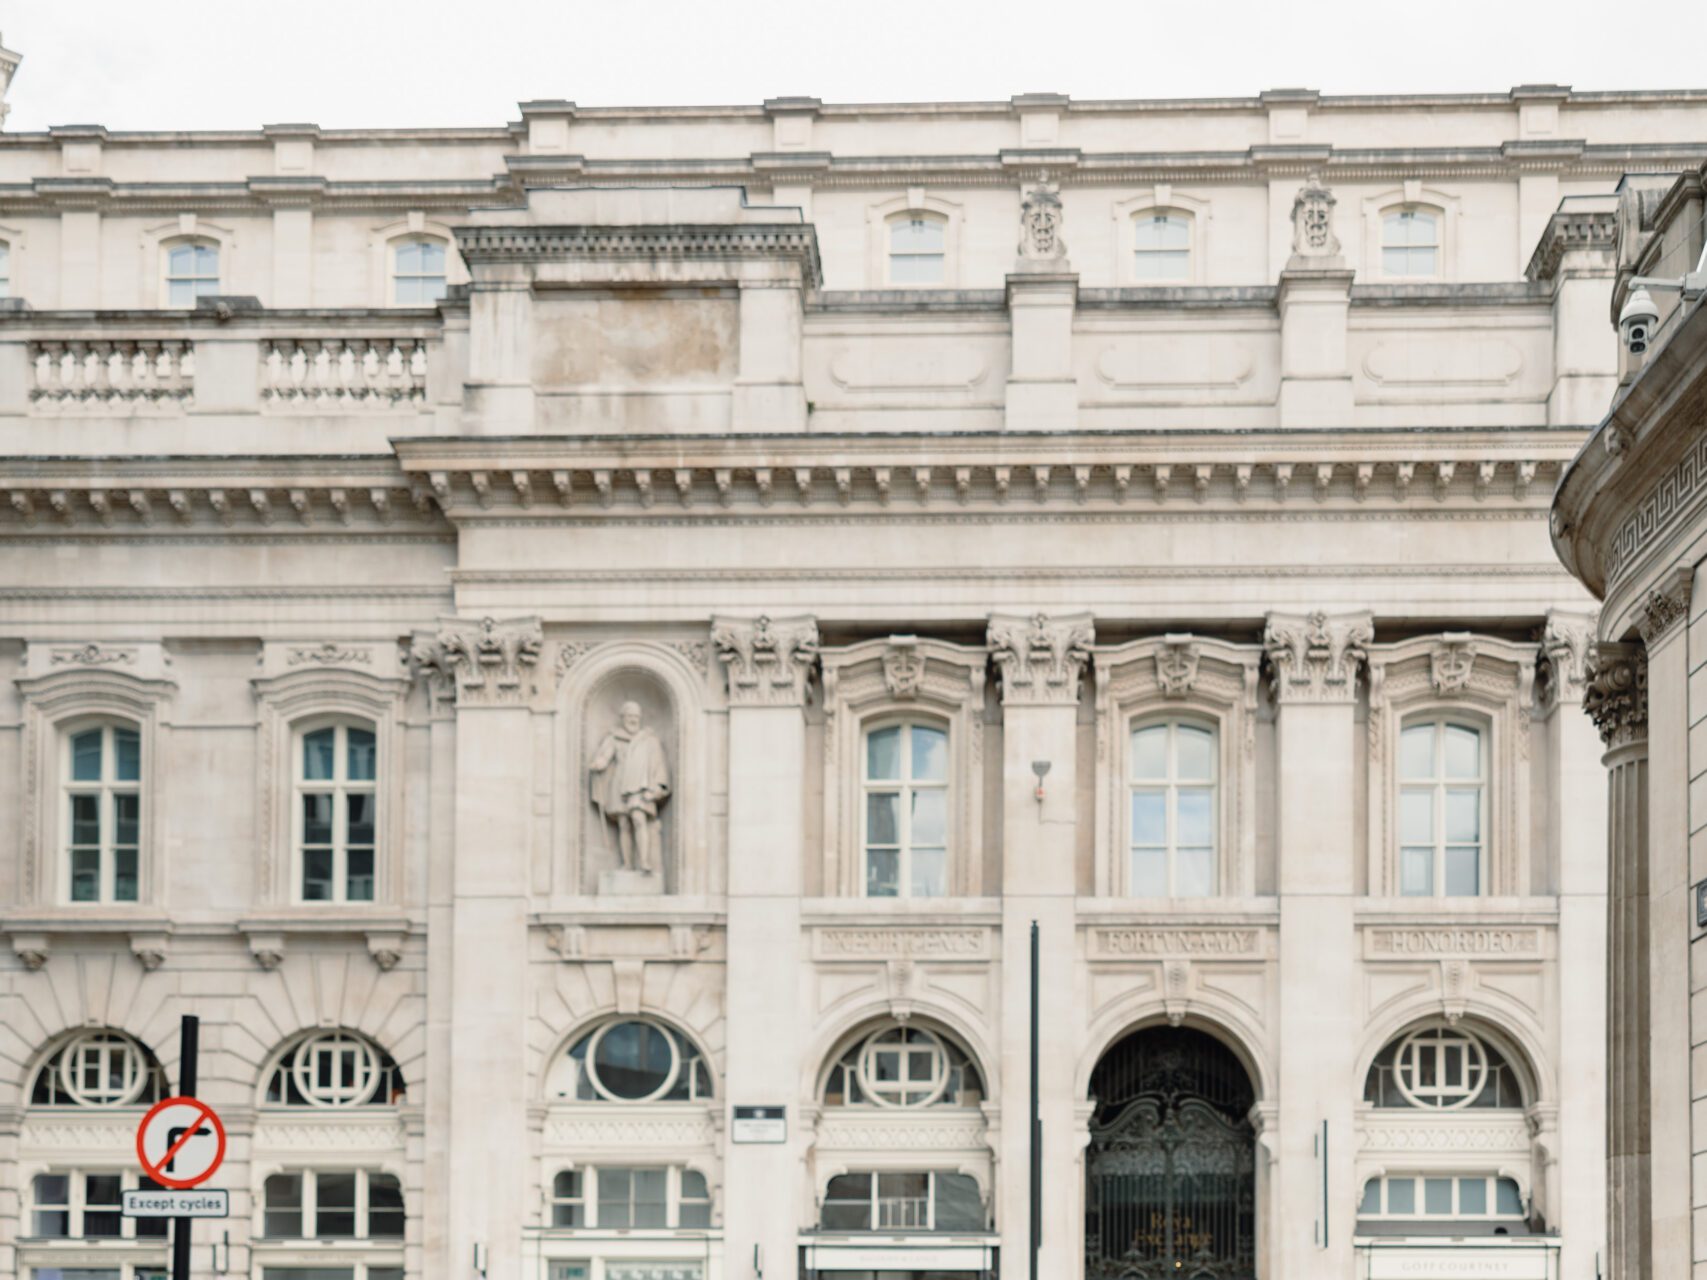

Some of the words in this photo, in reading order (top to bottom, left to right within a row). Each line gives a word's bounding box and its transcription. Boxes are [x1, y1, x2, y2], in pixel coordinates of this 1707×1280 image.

[129, 1197, 174, 1211] Except
[180, 1197, 222, 1211] cycles
[1151, 1212, 1192, 1232] Roya
[1135, 1229, 1213, 1249] Excange
